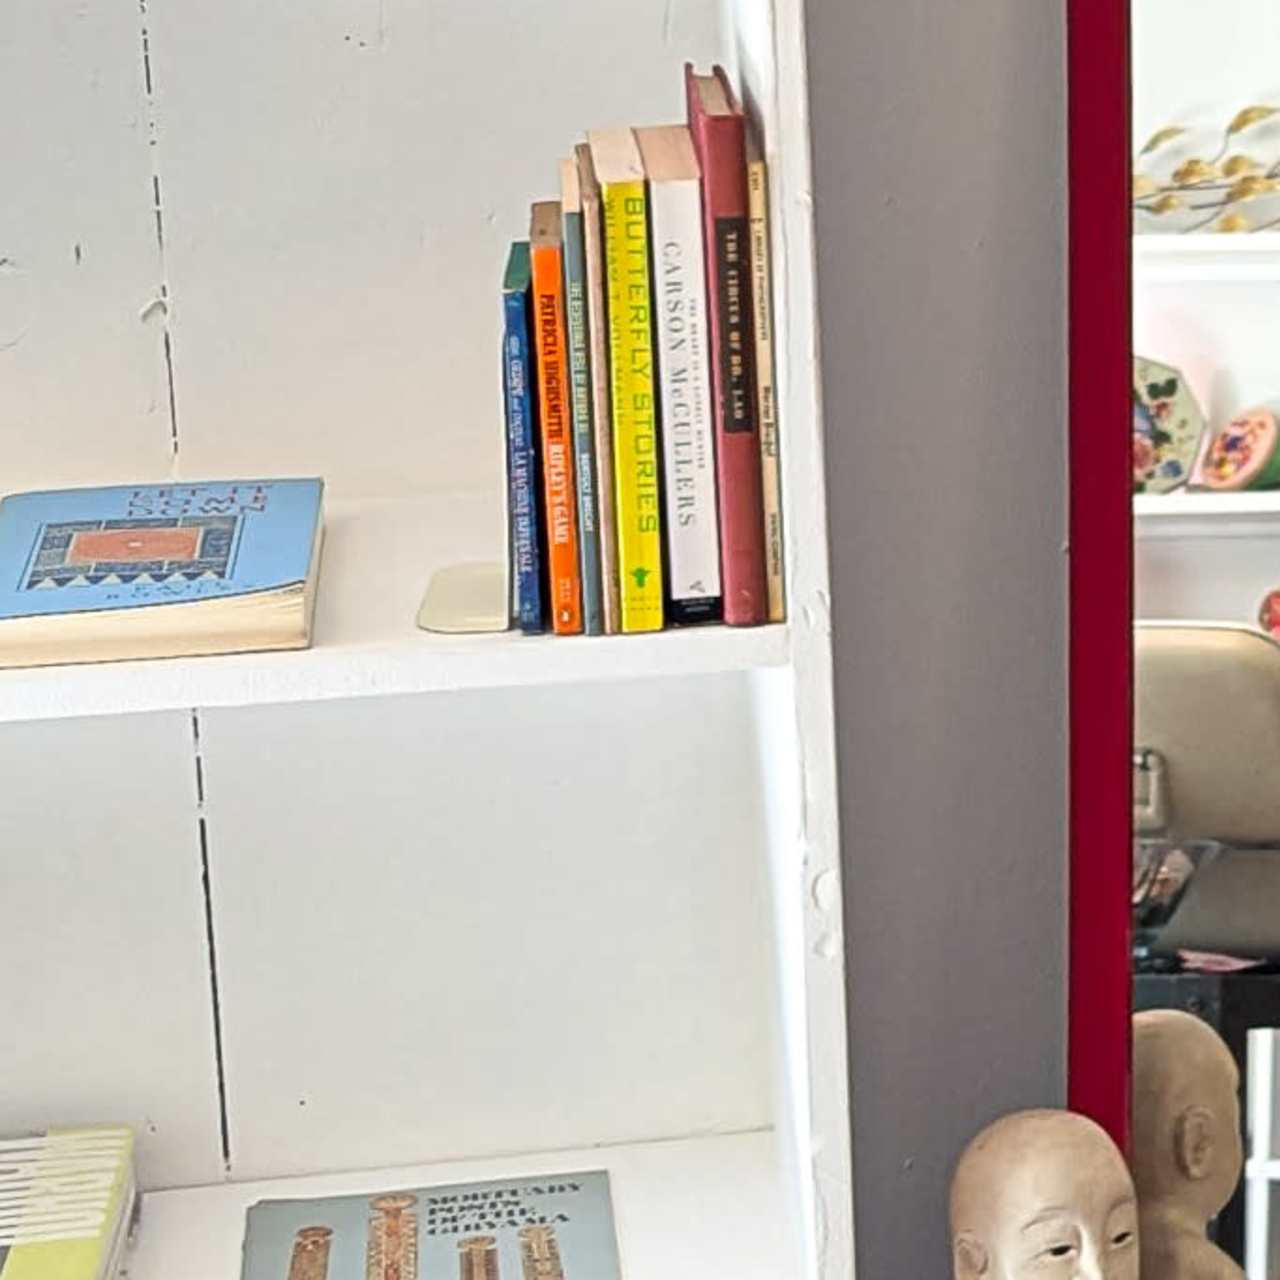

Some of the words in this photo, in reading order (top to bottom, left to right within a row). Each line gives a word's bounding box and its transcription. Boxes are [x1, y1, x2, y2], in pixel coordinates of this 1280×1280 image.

[604, 197, 621, 283] WILLIAM
[724, 231, 739, 263] THE
[541, 293, 560, 356] PATRICIA
[623, 196, 652, 379] BUTTERFLY
[663, 241, 692, 354] CARSON
[728, 329, 742, 349] OF
[544, 360, 564, 438] HIGHSMITH
[633, 391, 658, 534] STORIES
[668, 367, 697, 529] McCULLERS
[554, 506, 570, 545] GAME
